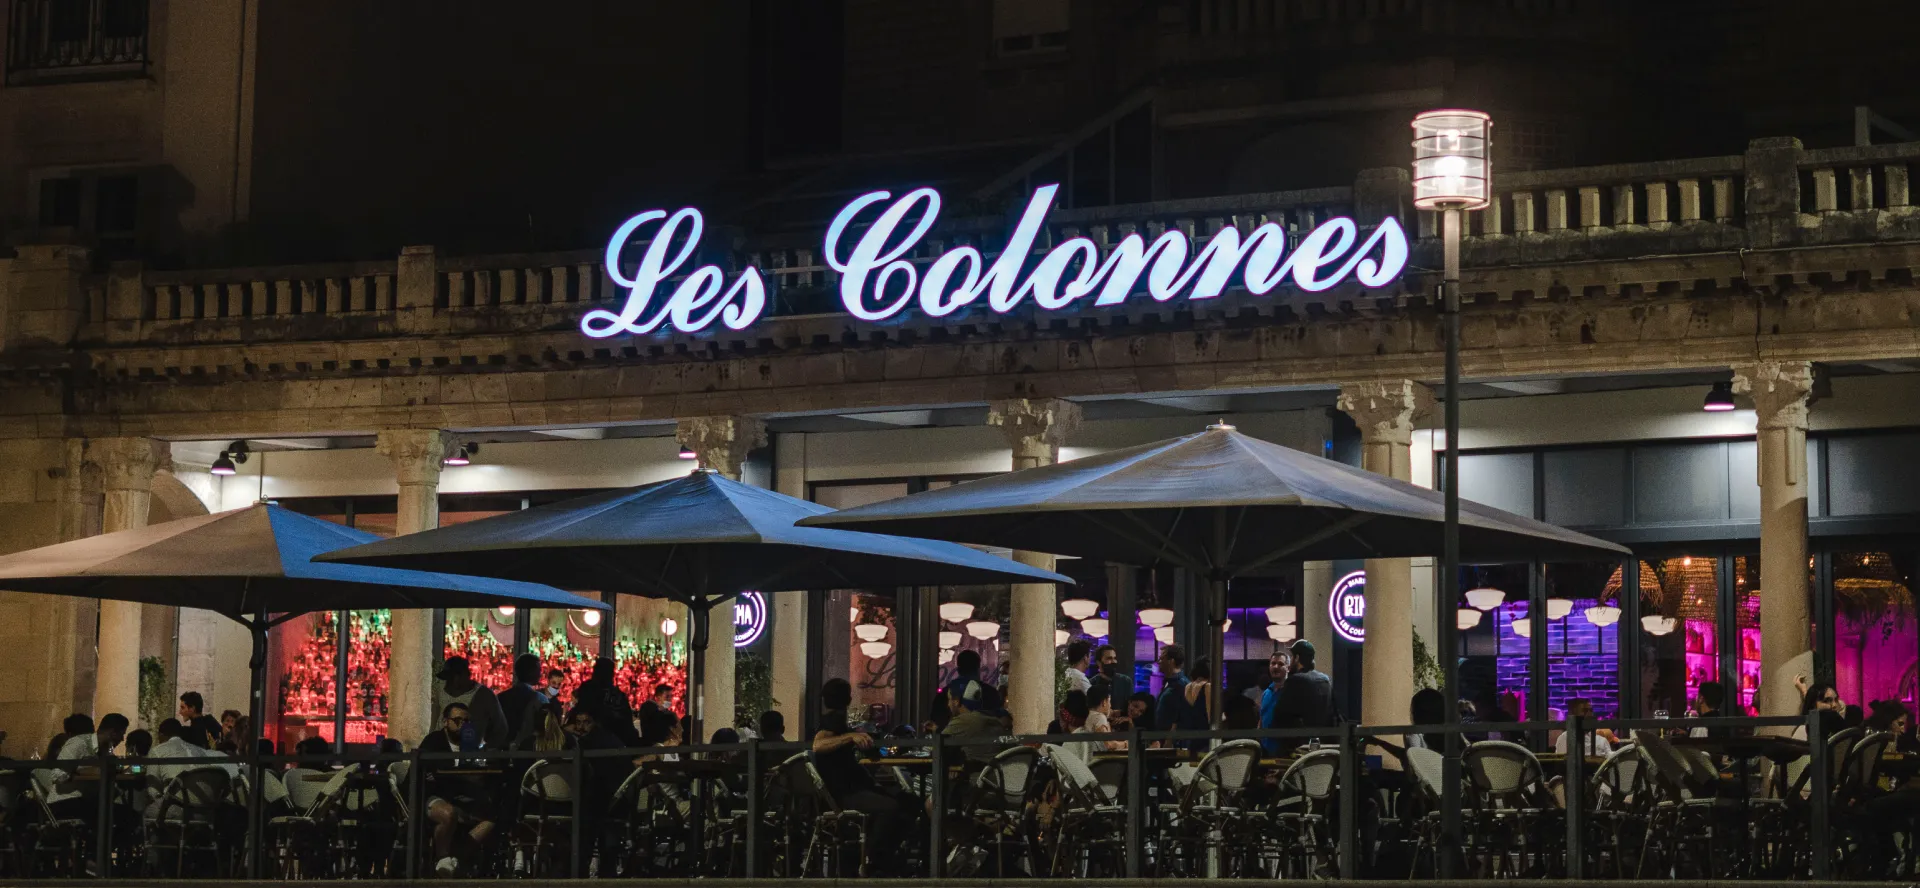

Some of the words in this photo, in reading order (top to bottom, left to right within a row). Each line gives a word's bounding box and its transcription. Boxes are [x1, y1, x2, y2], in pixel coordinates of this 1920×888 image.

[580, 207, 767, 339] Les
[823, 183, 1409, 321] Colonnes
[734, 604, 753, 625] MA
